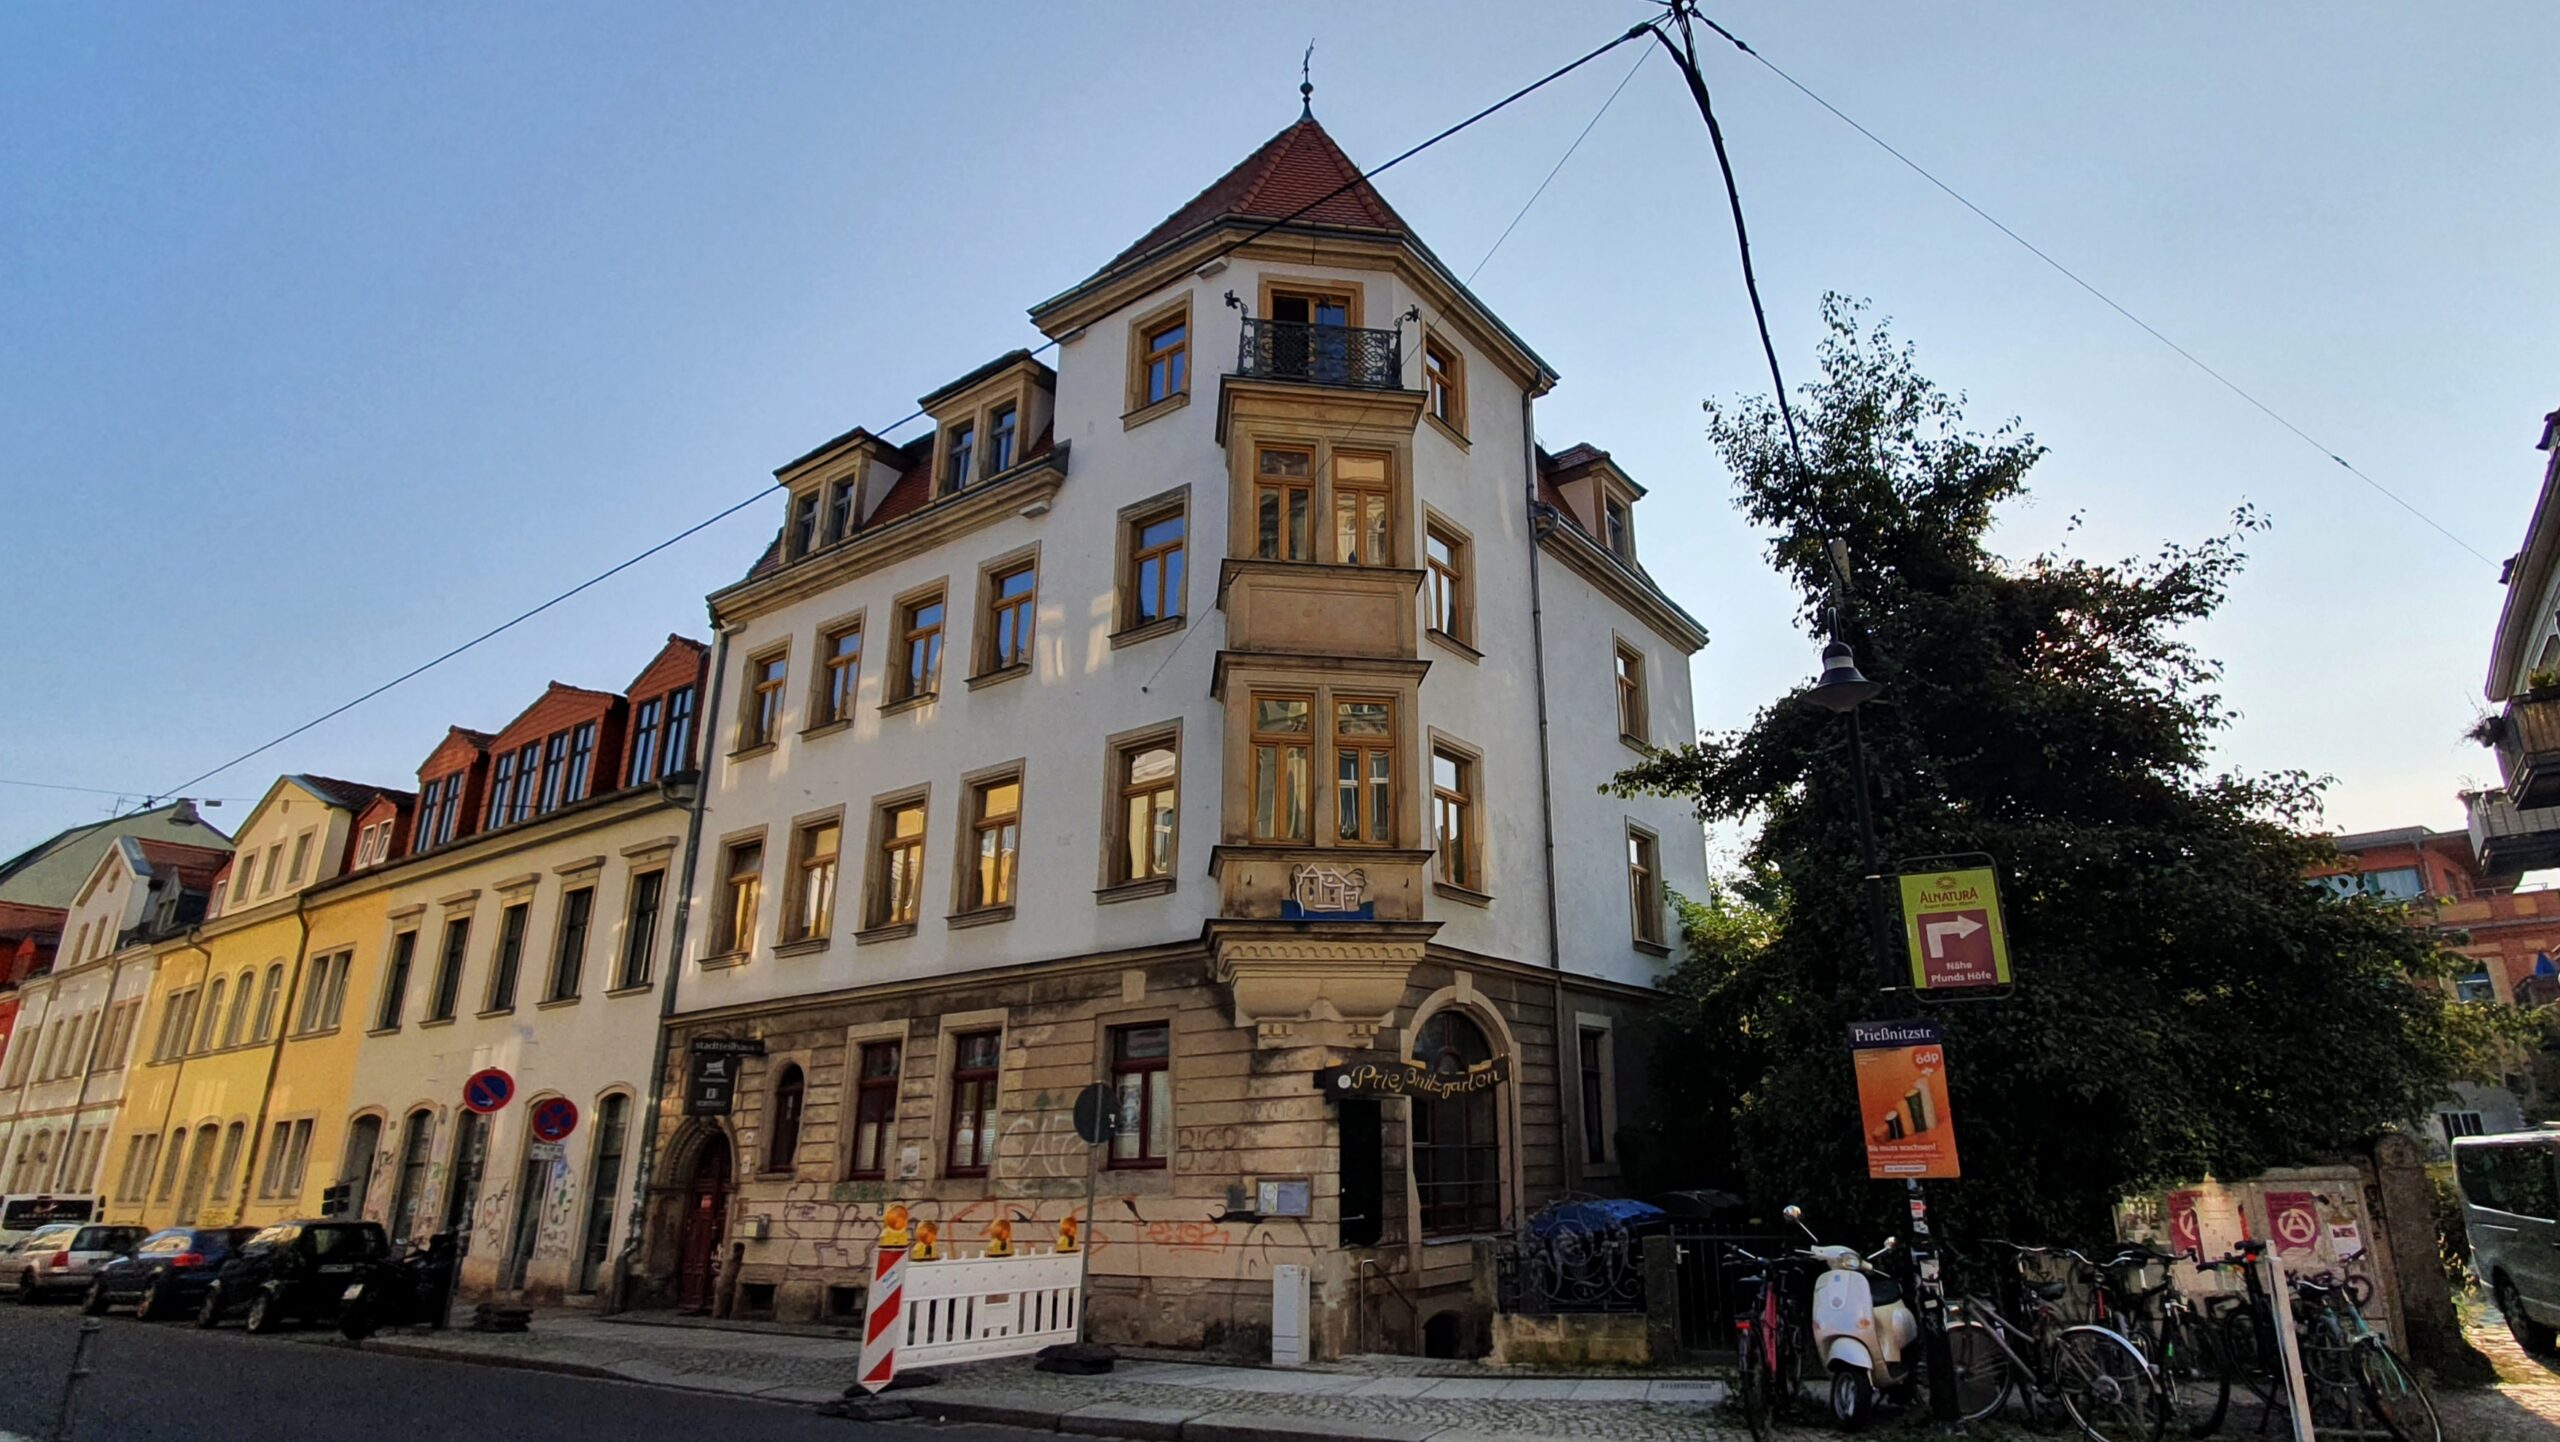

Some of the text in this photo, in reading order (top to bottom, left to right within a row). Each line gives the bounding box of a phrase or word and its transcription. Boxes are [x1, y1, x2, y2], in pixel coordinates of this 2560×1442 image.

[1920, 887, 1978, 904] ALNATURA
[1946, 961, 1973, 970] Nähe
[1931, 970, 1992, 983] Pfunds Höfe
[1855, 1026, 1935, 1042] Prießnitzstr.
[1915, 1051, 1940, 1065] ödp
[1351, 1064, 1501, 1100] Prießnitzgarten
